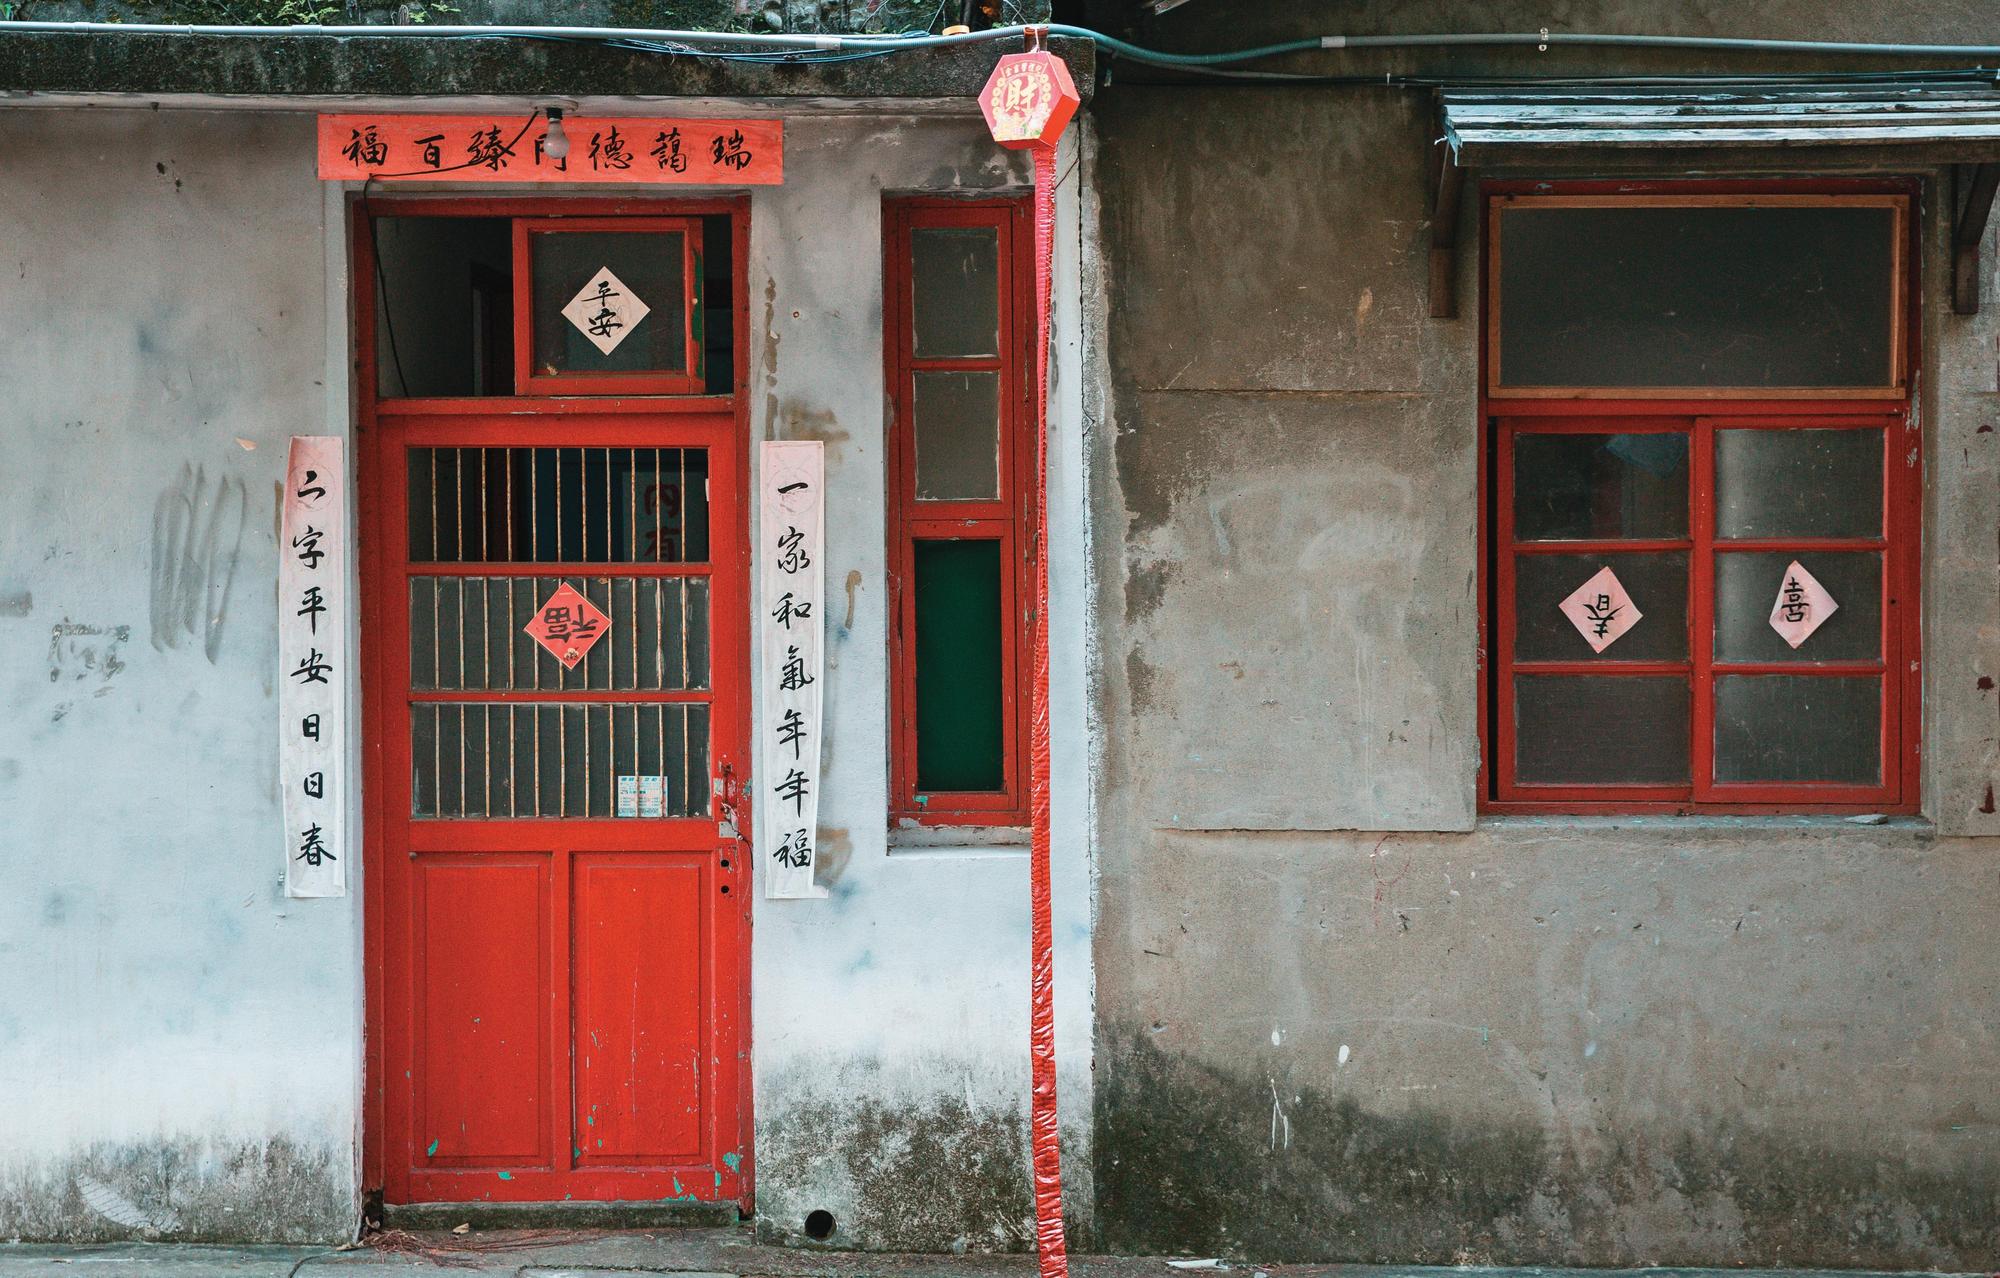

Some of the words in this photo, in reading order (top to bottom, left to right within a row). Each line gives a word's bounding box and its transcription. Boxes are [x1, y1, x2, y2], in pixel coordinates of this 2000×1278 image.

[1005, 74, 1038, 112] 財
[581, 281, 622, 338] 平安
[543, 604, 600, 644] 福
[1582, 593, 1626, 640] 春
[1780, 576, 1810, 624] 喜
[291, 470, 337, 867] 二字平安日日春
[772, 482, 815, 869] 一家和氣年年福
